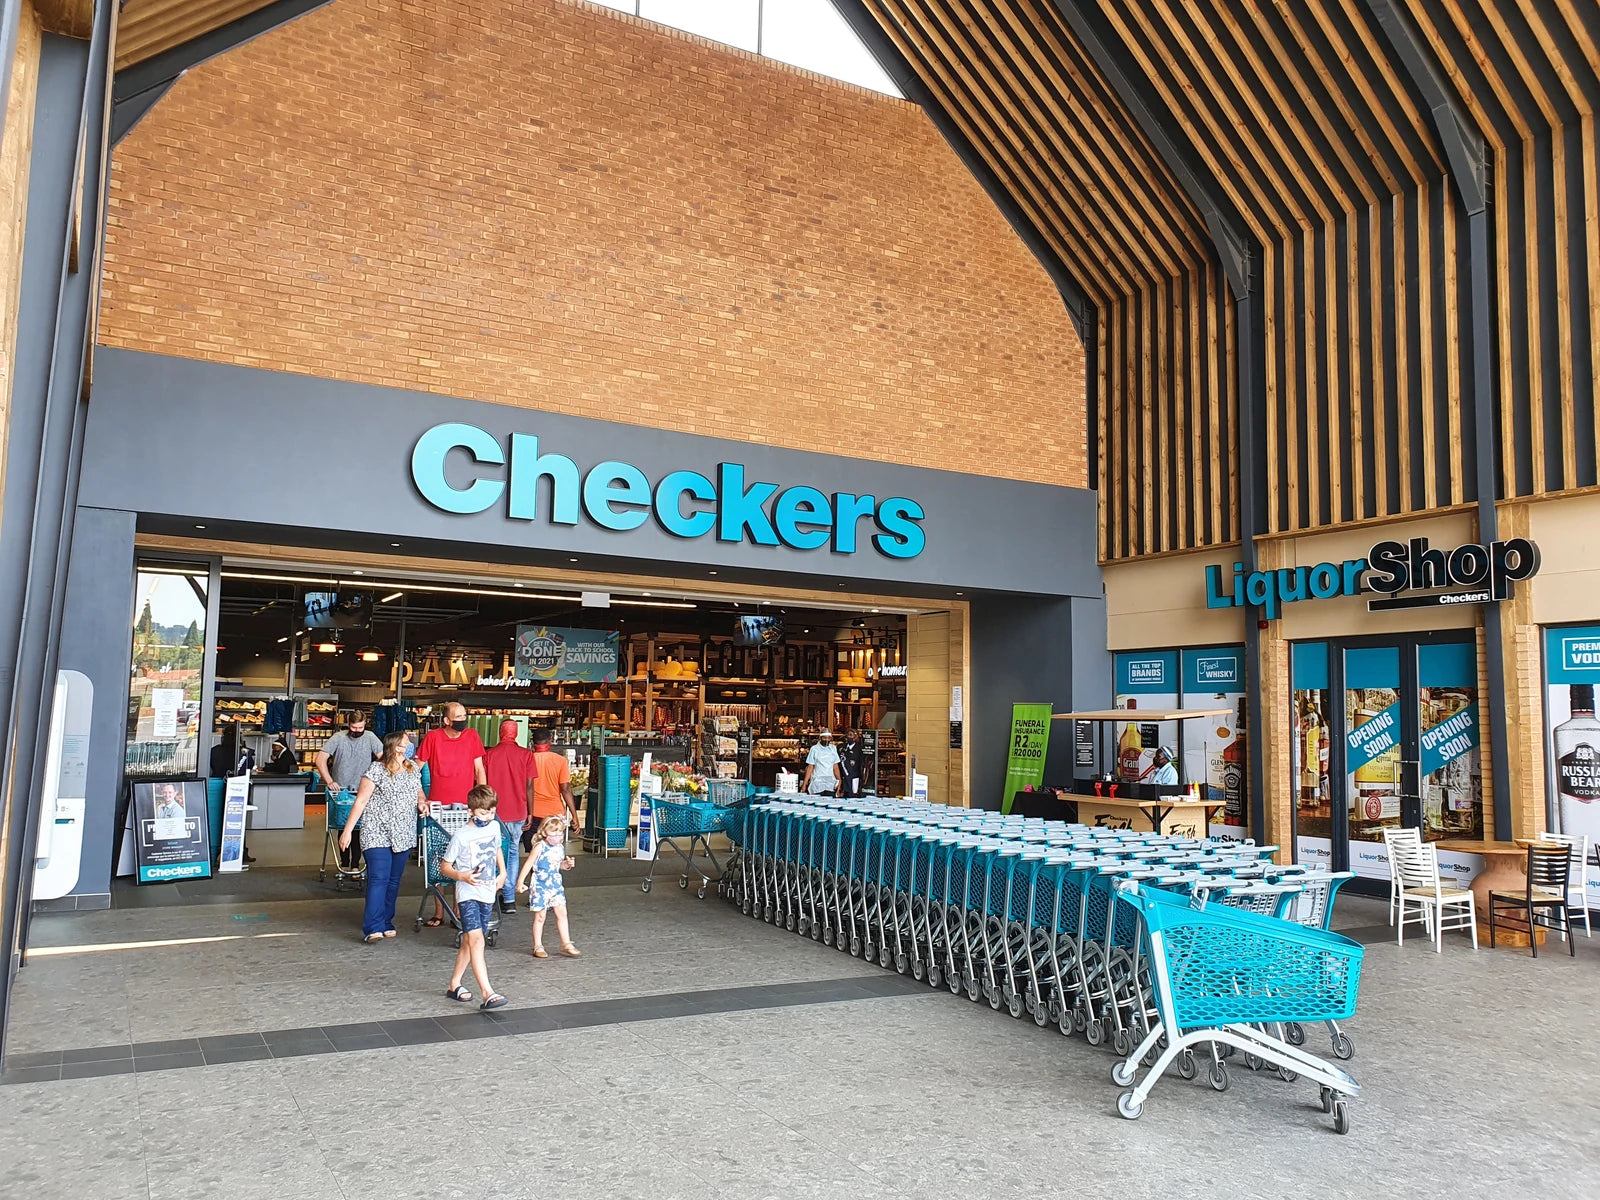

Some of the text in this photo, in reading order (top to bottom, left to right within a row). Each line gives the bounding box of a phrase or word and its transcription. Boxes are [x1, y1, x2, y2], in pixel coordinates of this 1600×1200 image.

[411, 421, 927, 561] Checkers
[1206, 537, 1541, 620] LiquorShop
[1439, 592, 1489, 606] Checkers
[522, 646, 563, 658] DONE
[567, 653, 616, 664] SAVINGS
[1131, 669, 1161, 677] BRANDS
[1200, 660, 1219, 675] Finest
[1205, 670, 1234, 678] WHISKY
[477, 675, 531, 690] baked fresh
[1015, 719, 1046, 728] FUNERAL
[1015, 727, 1045, 735] INSURANCE
[1348, 712, 1394, 749] OPENING
[1421, 711, 1473, 750] OPENING
[1363, 731, 1394, 758] SOON
[1437, 735, 1473, 761] SOON
[1301, 847, 1331, 857] LiquorShop
[147, 864, 203, 879] Checkers
